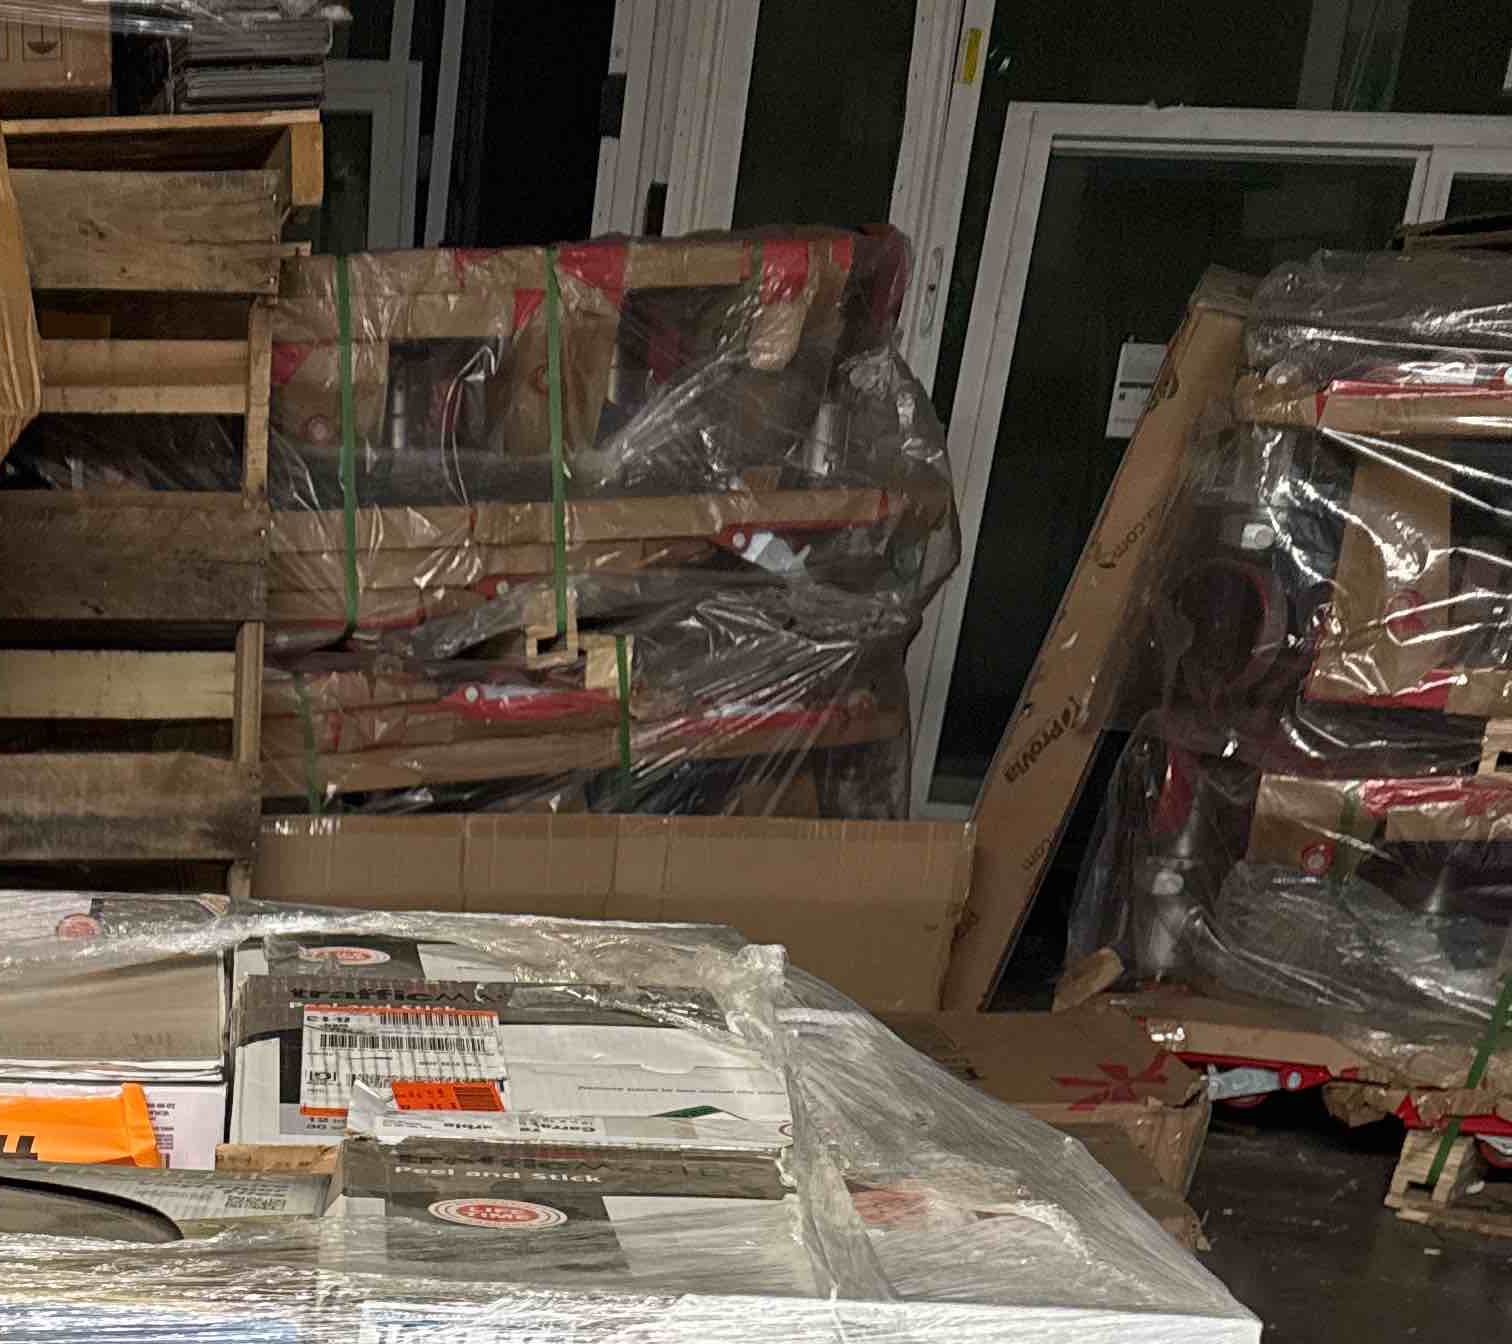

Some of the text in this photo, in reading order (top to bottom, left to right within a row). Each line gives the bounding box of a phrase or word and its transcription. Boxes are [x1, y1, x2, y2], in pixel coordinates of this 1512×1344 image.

[395, 1166, 602, 1184] Peel and Stick
